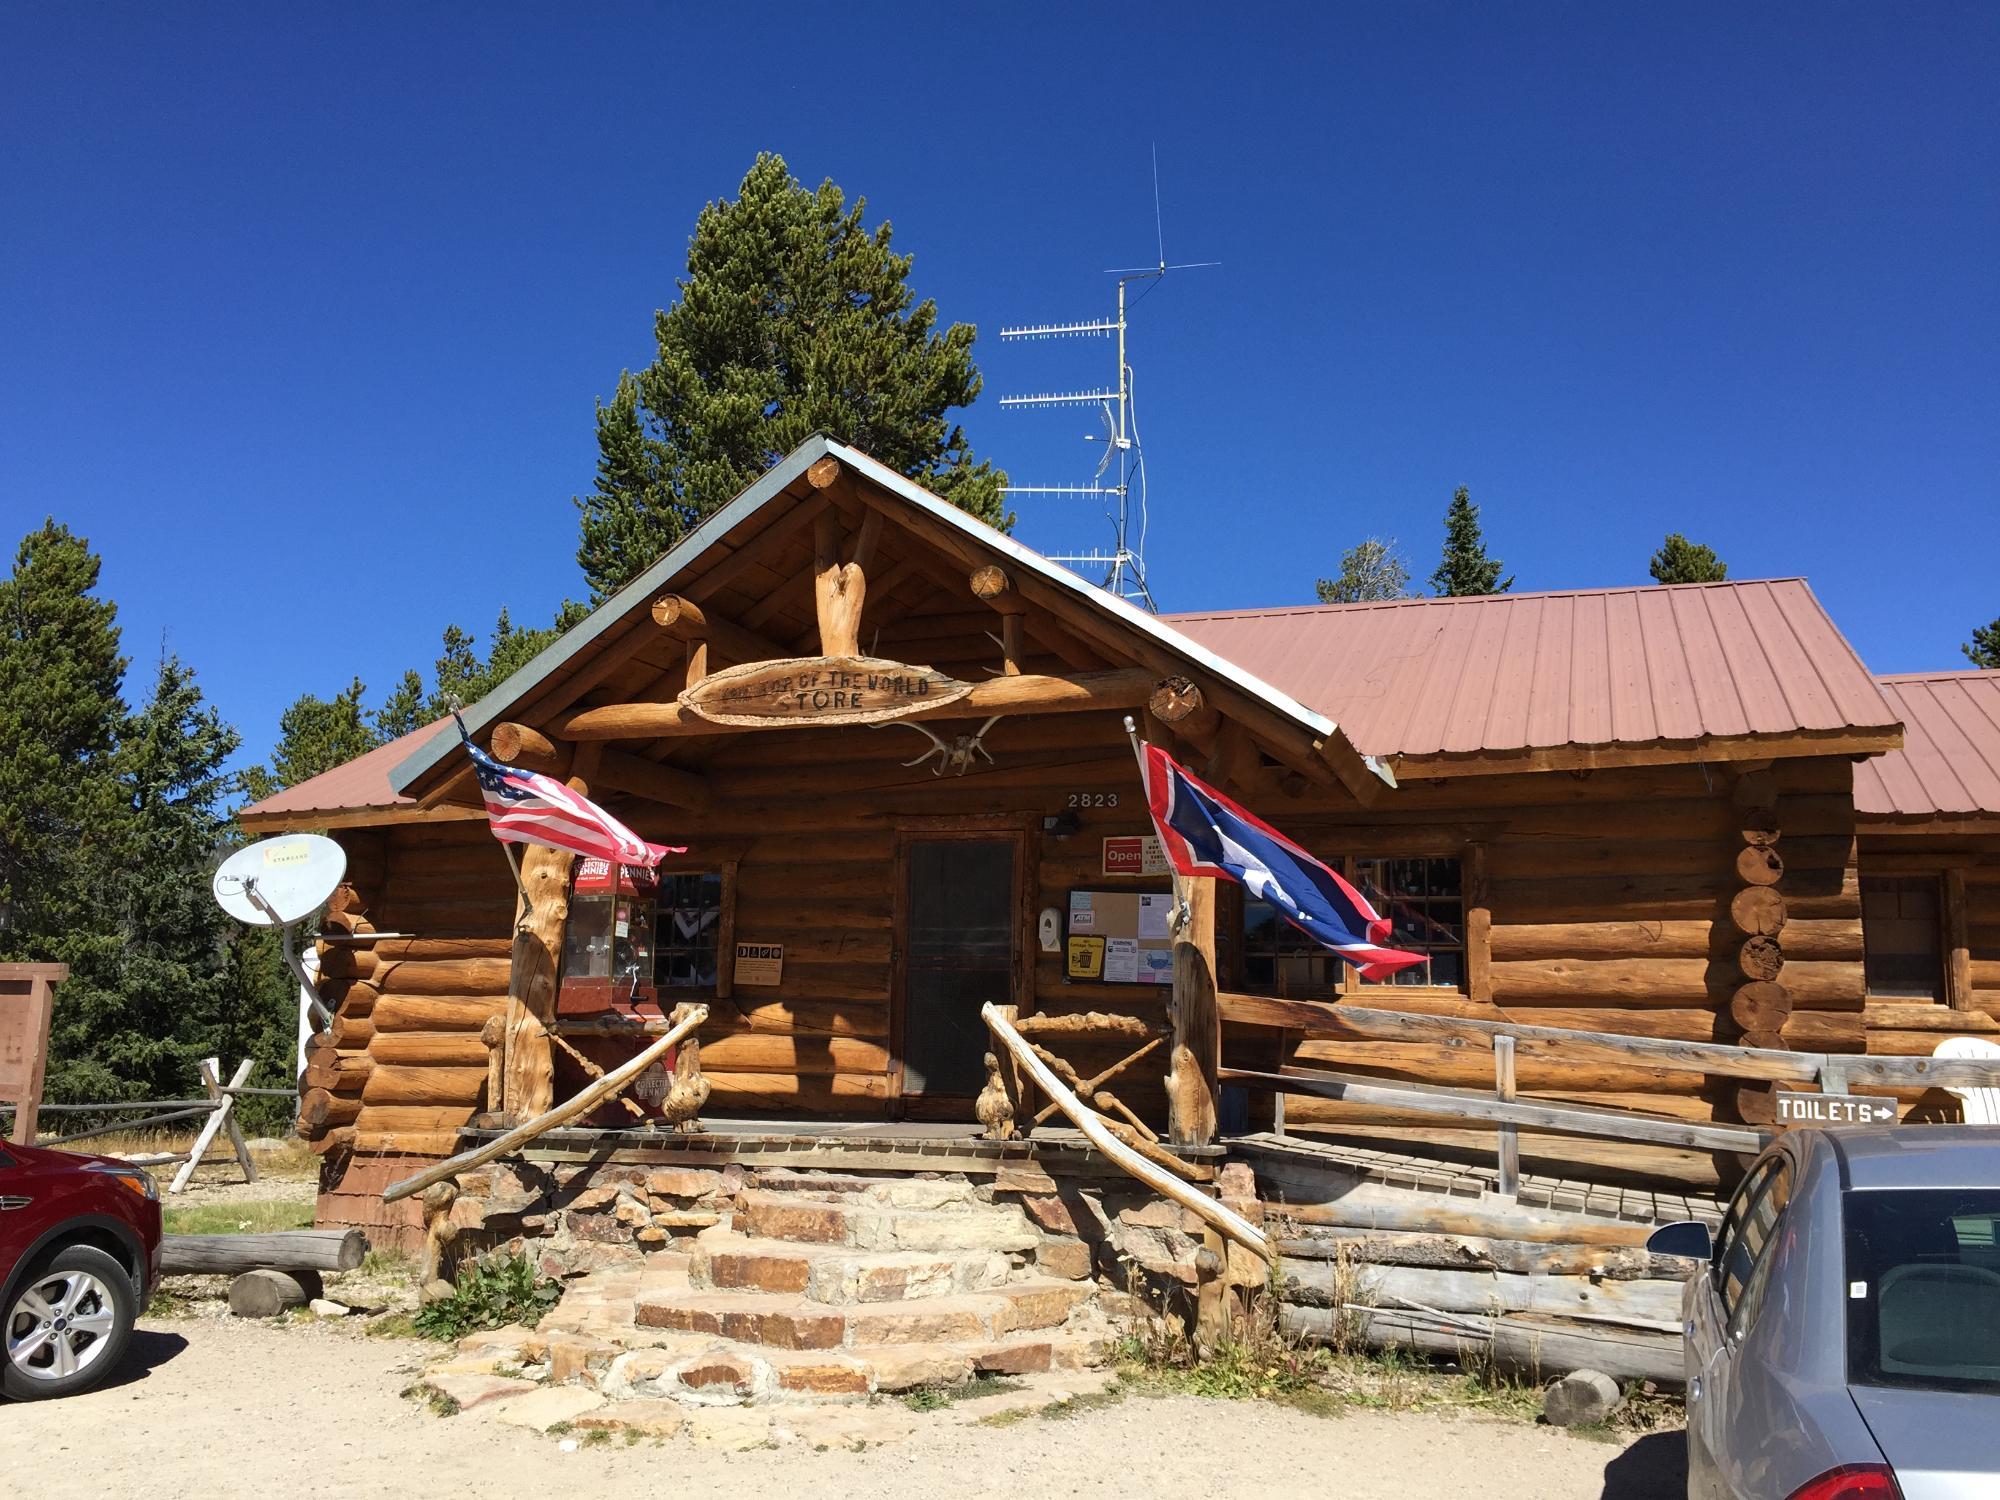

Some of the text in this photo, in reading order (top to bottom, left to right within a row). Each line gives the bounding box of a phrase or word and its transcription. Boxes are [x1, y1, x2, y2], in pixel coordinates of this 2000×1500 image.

[868, 674, 928, 697] WORLD
[1068, 794, 1118, 808] 2823
[1108, 850, 1141, 862] Open
[574, 866, 609, 877] PENNIES
[1779, 1099, 1872, 1122] TOILETS
